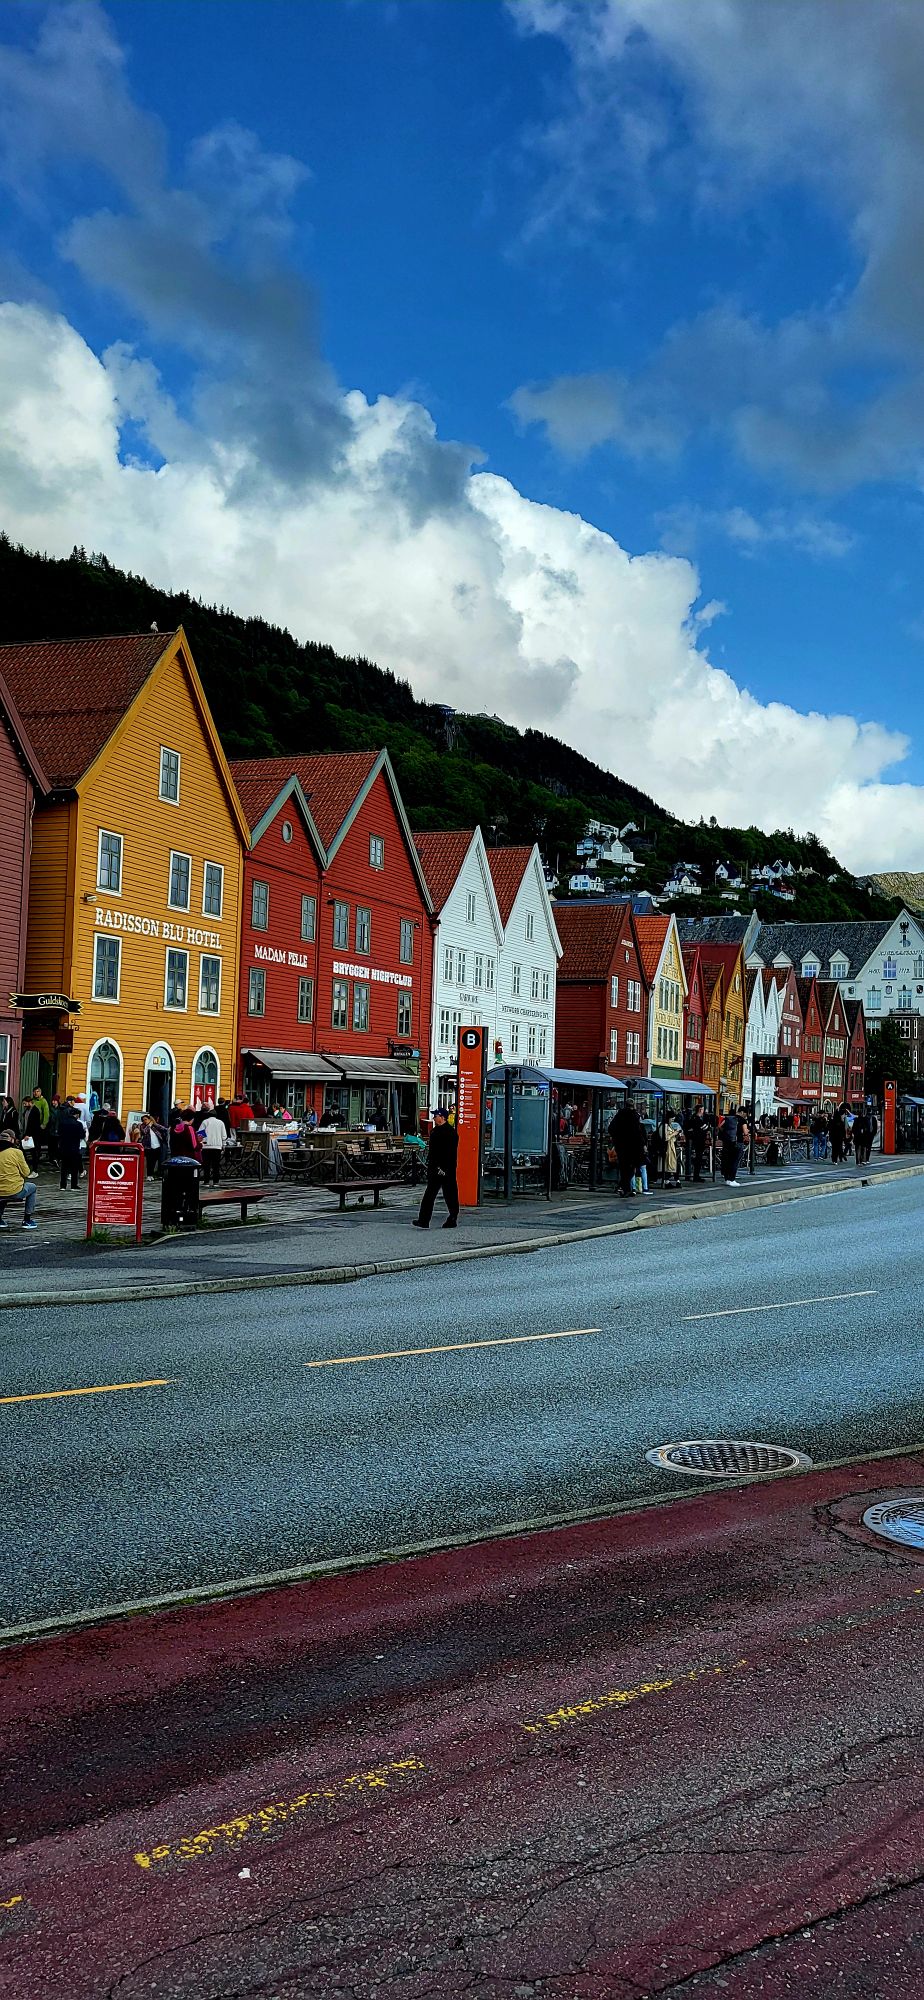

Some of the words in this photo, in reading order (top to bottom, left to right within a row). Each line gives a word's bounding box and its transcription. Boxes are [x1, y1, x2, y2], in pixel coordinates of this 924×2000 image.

[94, 907, 160, 937] RADISSON
[162, 921, 184, 942] BLU
[186, 927, 222, 950] HOTEL
[254, 944, 287, 964] MADAM
[287, 951, 308, 969] FELLE
[333, 961, 370, 979] BRYGGEN
[371, 969, 413, 987] NIGHTCLUB
[467, 1033, 476, 1046] B
